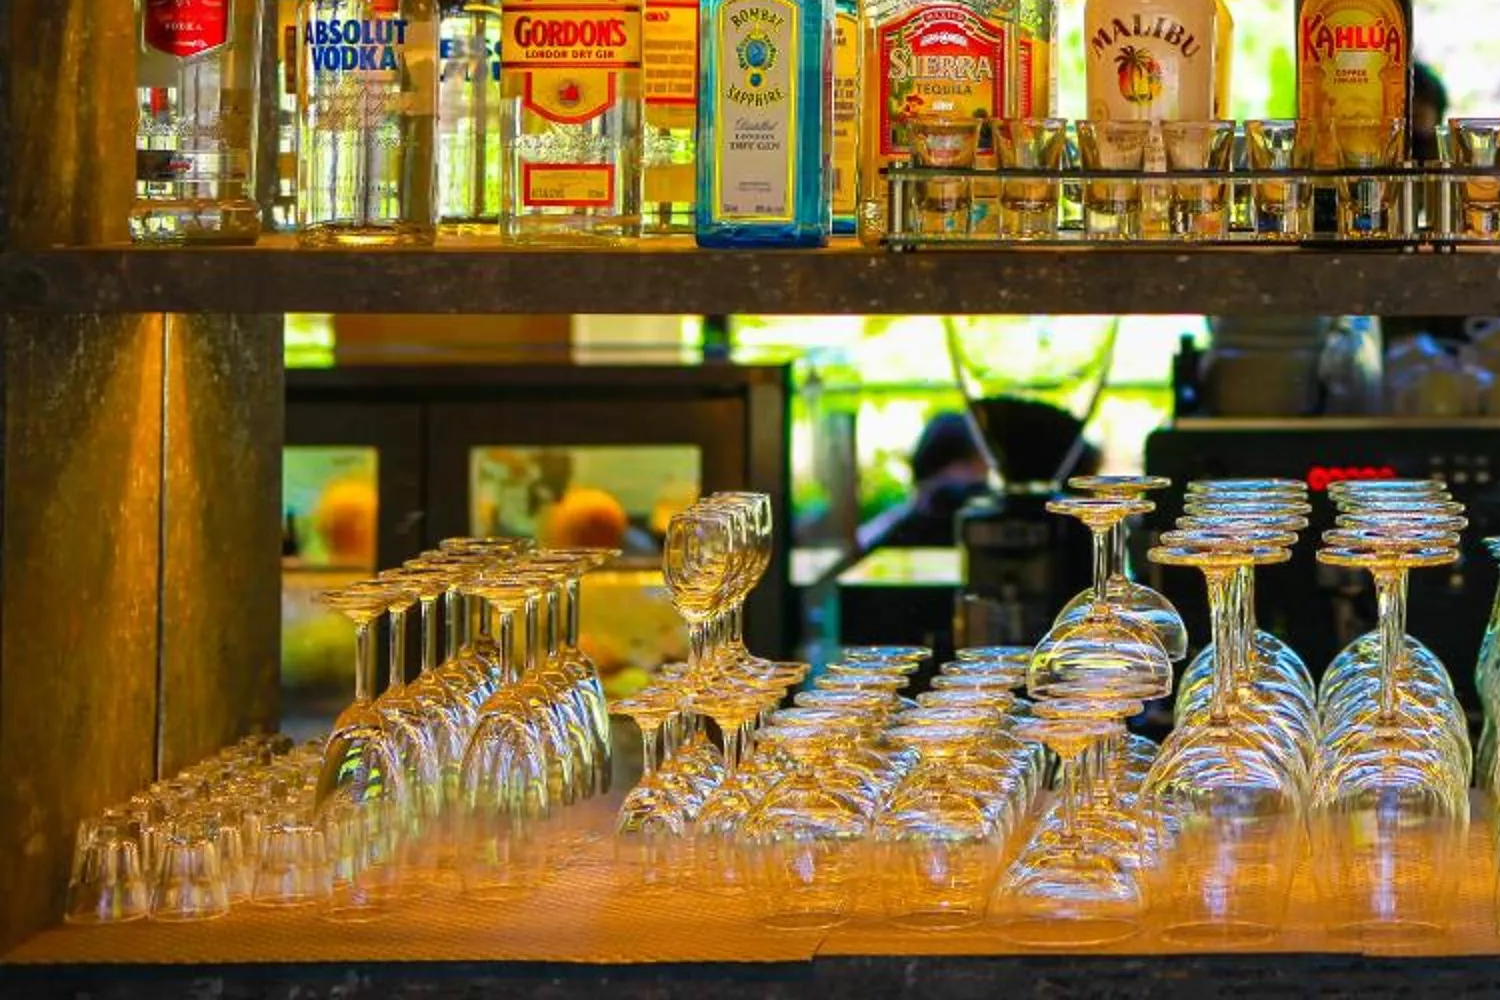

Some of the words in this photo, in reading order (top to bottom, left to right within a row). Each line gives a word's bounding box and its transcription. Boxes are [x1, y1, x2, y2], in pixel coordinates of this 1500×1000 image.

[729, 7, 785, 29] BOMBAY
[305, 19, 408, 45] ABSOLUT
[514, 15, 627, 48] GORDON'S
[1091, 13, 1201, 59] MALIBU
[310, 45, 399, 71] VODKA
[525, 50, 568, 59] LONDON
[571, 50, 592, 59] DRY
[596, 50, 615, 59] GIN
[888, 46, 994, 83] SIERRA
[726, 83, 786, 108] SAPPHIRE
[915, 83, 973, 96] TEQUILA
